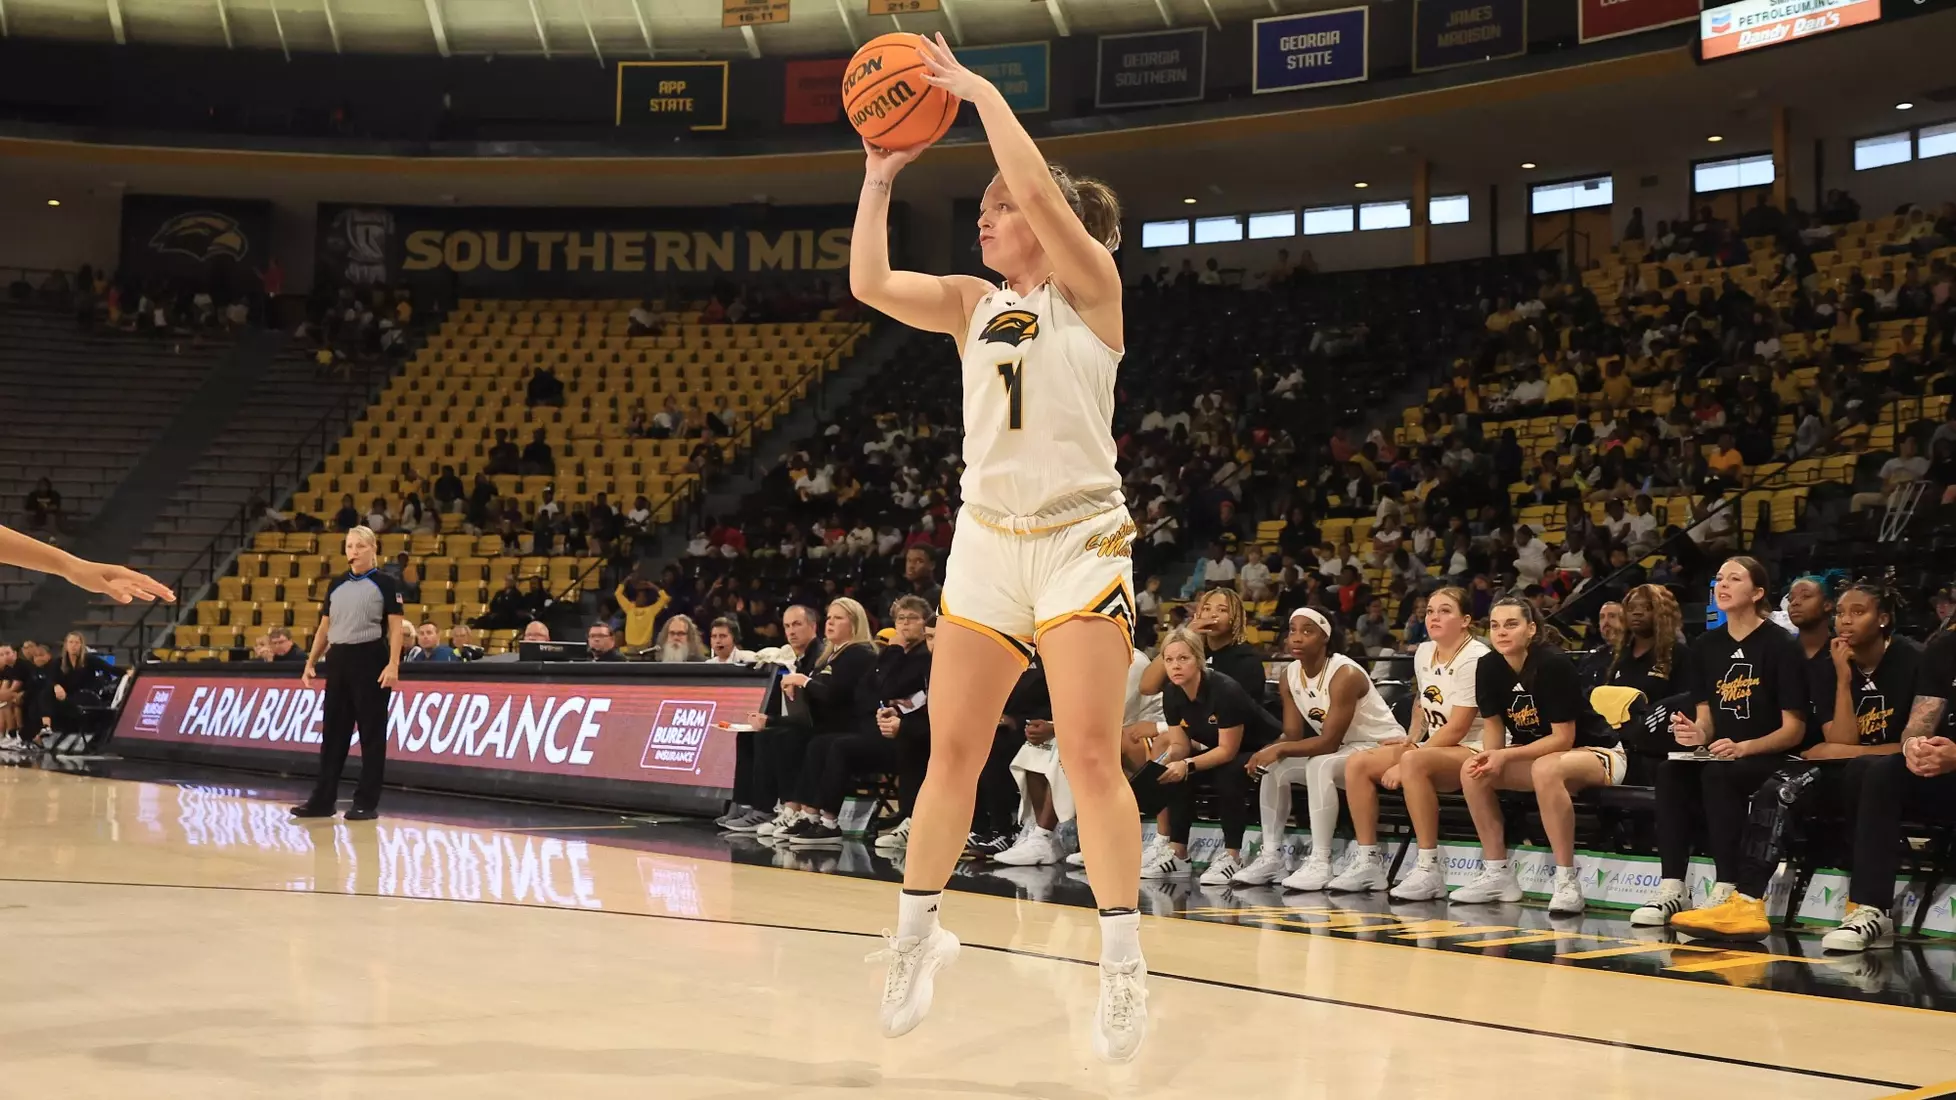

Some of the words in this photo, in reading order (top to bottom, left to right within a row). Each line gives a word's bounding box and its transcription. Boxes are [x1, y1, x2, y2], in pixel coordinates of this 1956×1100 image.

[1446, 5, 1493, 27] JAMES
[1280, 30, 1340, 51] GEORGIA
[1437, 23, 1502, 47] MADISON
[1738, 24, 1789, 49] Dandy
[1791, 11, 1840, 37] Dan's
[1123, 49, 1180, 68] GEORGIA
[1287, 50, 1333, 69] STATE
[844, 56, 883, 96] NCAA
[1115, 66, 1187, 88] SOUTHERN
[659, 80, 686, 95] APP
[649, 98, 694, 112] STATE
[851, 80, 916, 127] Wilson
[403, 229, 736, 272] SOUTHERN
[747, 228, 853, 272] MIS
[996, 356, 1024, 431] 1
[1716, 674, 1760, 694] Southern
[1721, 688, 1752, 702] Miss
[179, 686, 253, 738] FARM
[672, 708, 707, 727] FARM
[653, 726, 703, 745] BUREAU
[654, 750, 695, 762] INSURANCE
